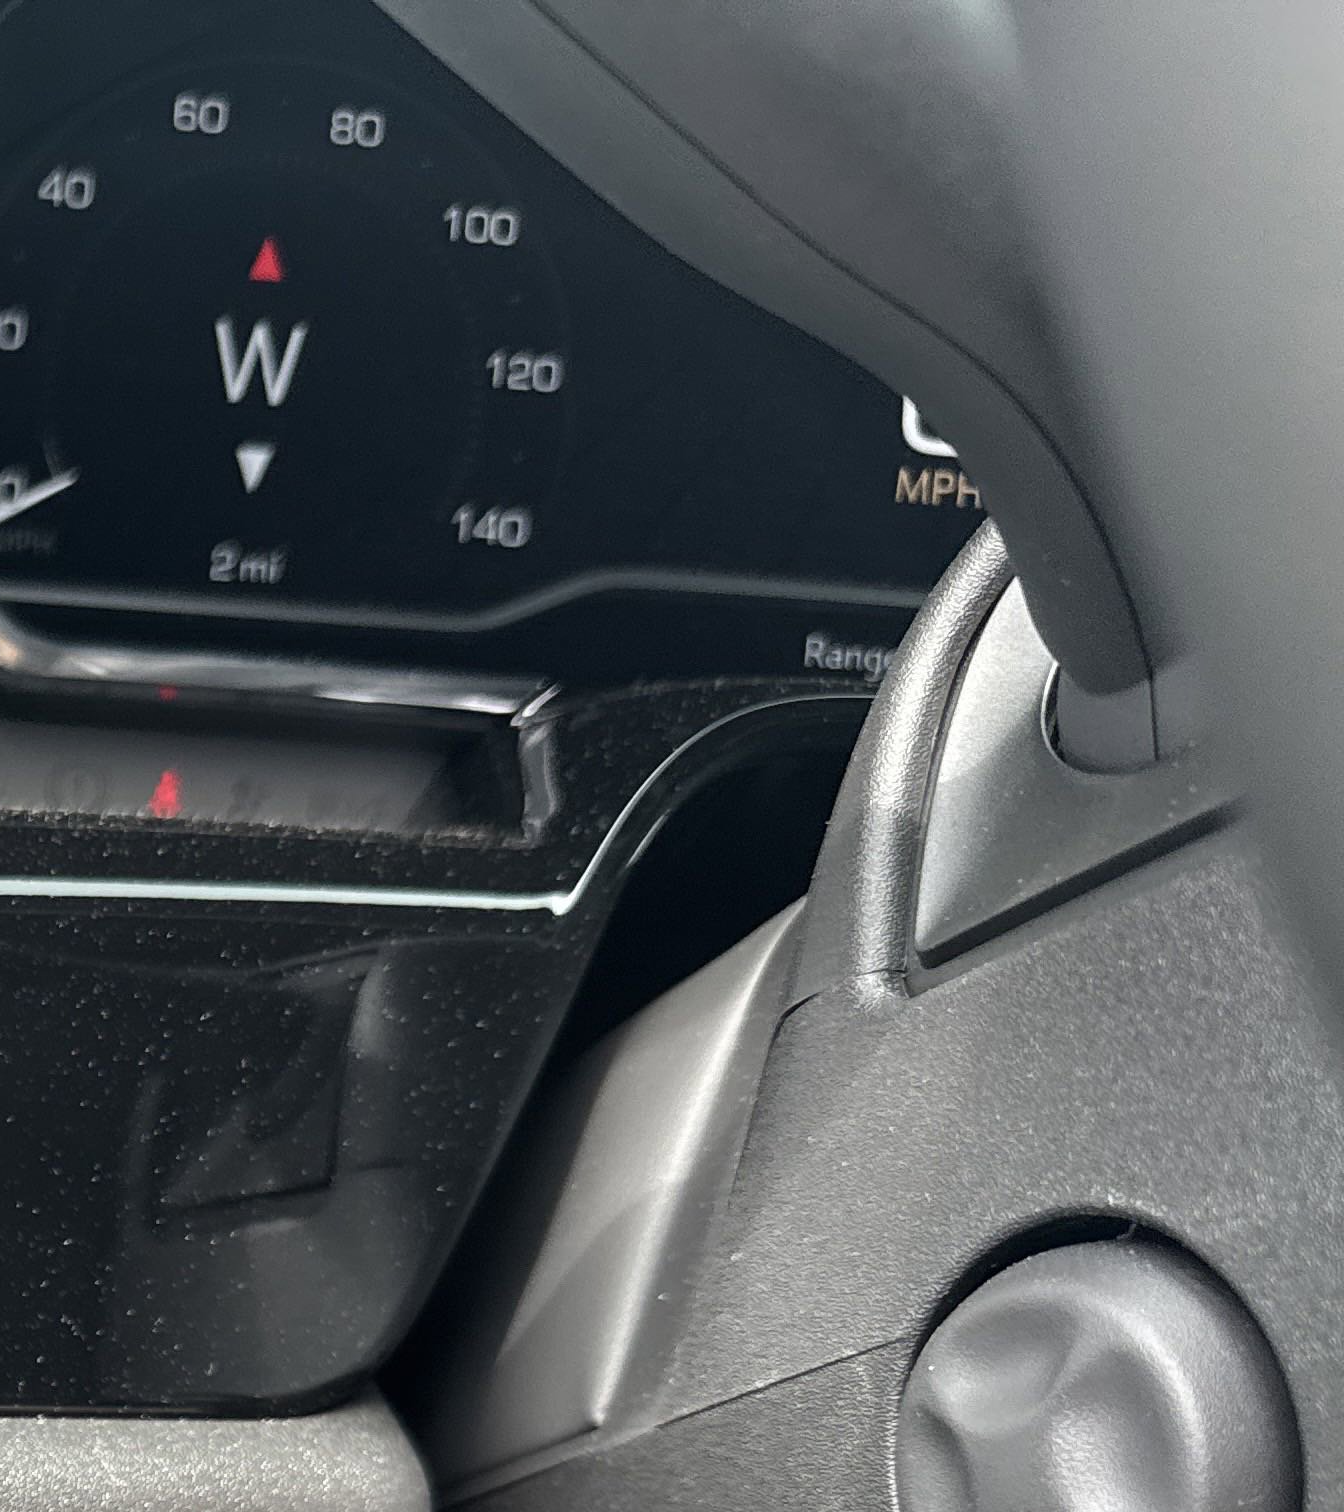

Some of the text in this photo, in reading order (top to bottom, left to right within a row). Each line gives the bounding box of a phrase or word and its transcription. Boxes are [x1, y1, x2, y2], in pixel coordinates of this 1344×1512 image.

[173, 92, 230, 135] 60
[329, 107, 386, 148] 80
[37, 168, 96, 210] 40
[443, 203, 522, 247] 100
[215, 318, 308, 407] W
[486, 351, 563, 393] 120
[452, 505, 531, 548] 140
